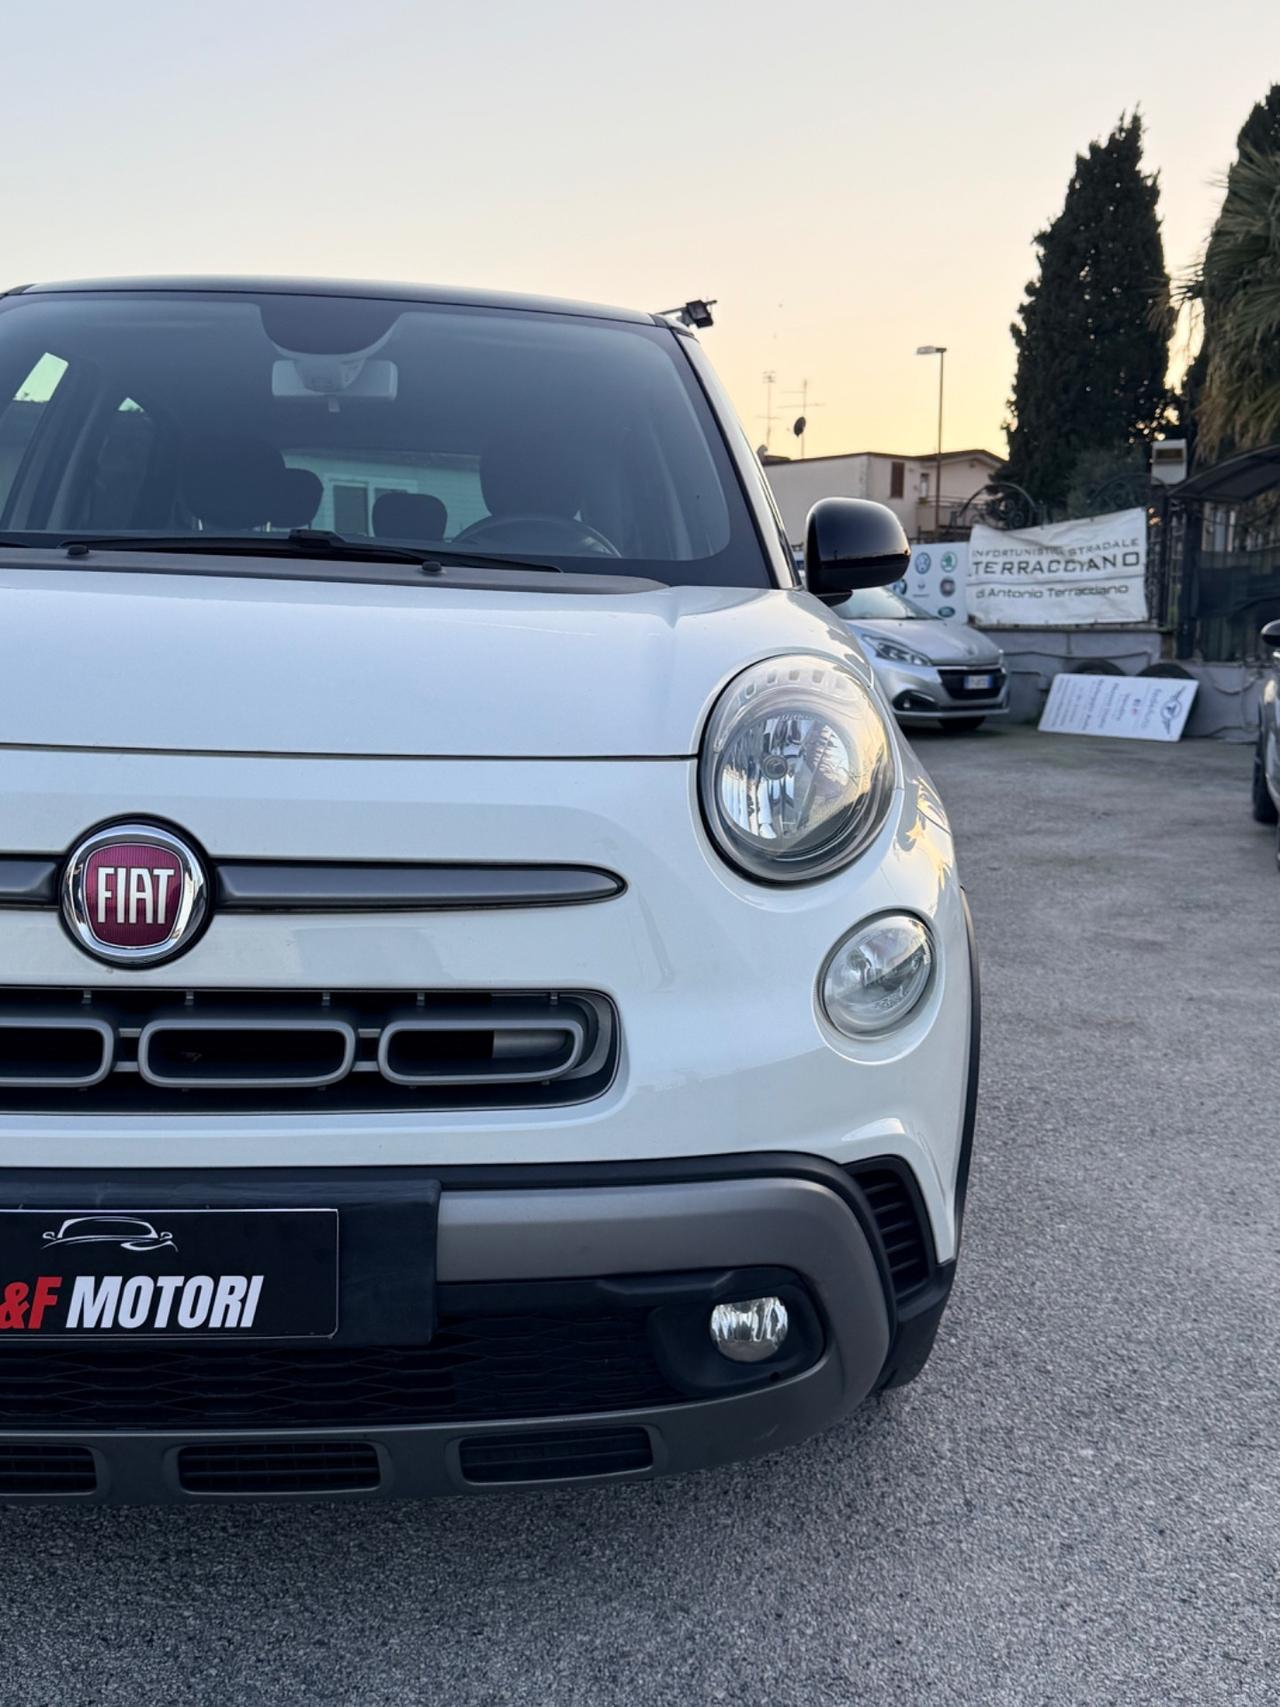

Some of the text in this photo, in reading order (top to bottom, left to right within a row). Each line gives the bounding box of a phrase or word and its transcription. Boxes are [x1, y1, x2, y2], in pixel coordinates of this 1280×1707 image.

[1068, 538, 1139, 556] STRADALE
[972, 552, 1140, 575] TERRACCIANO
[988, 588, 1043, 599] Antonio
[97, 866, 175, 925] FIAT
[65, 1275, 264, 1329] MOTORI
